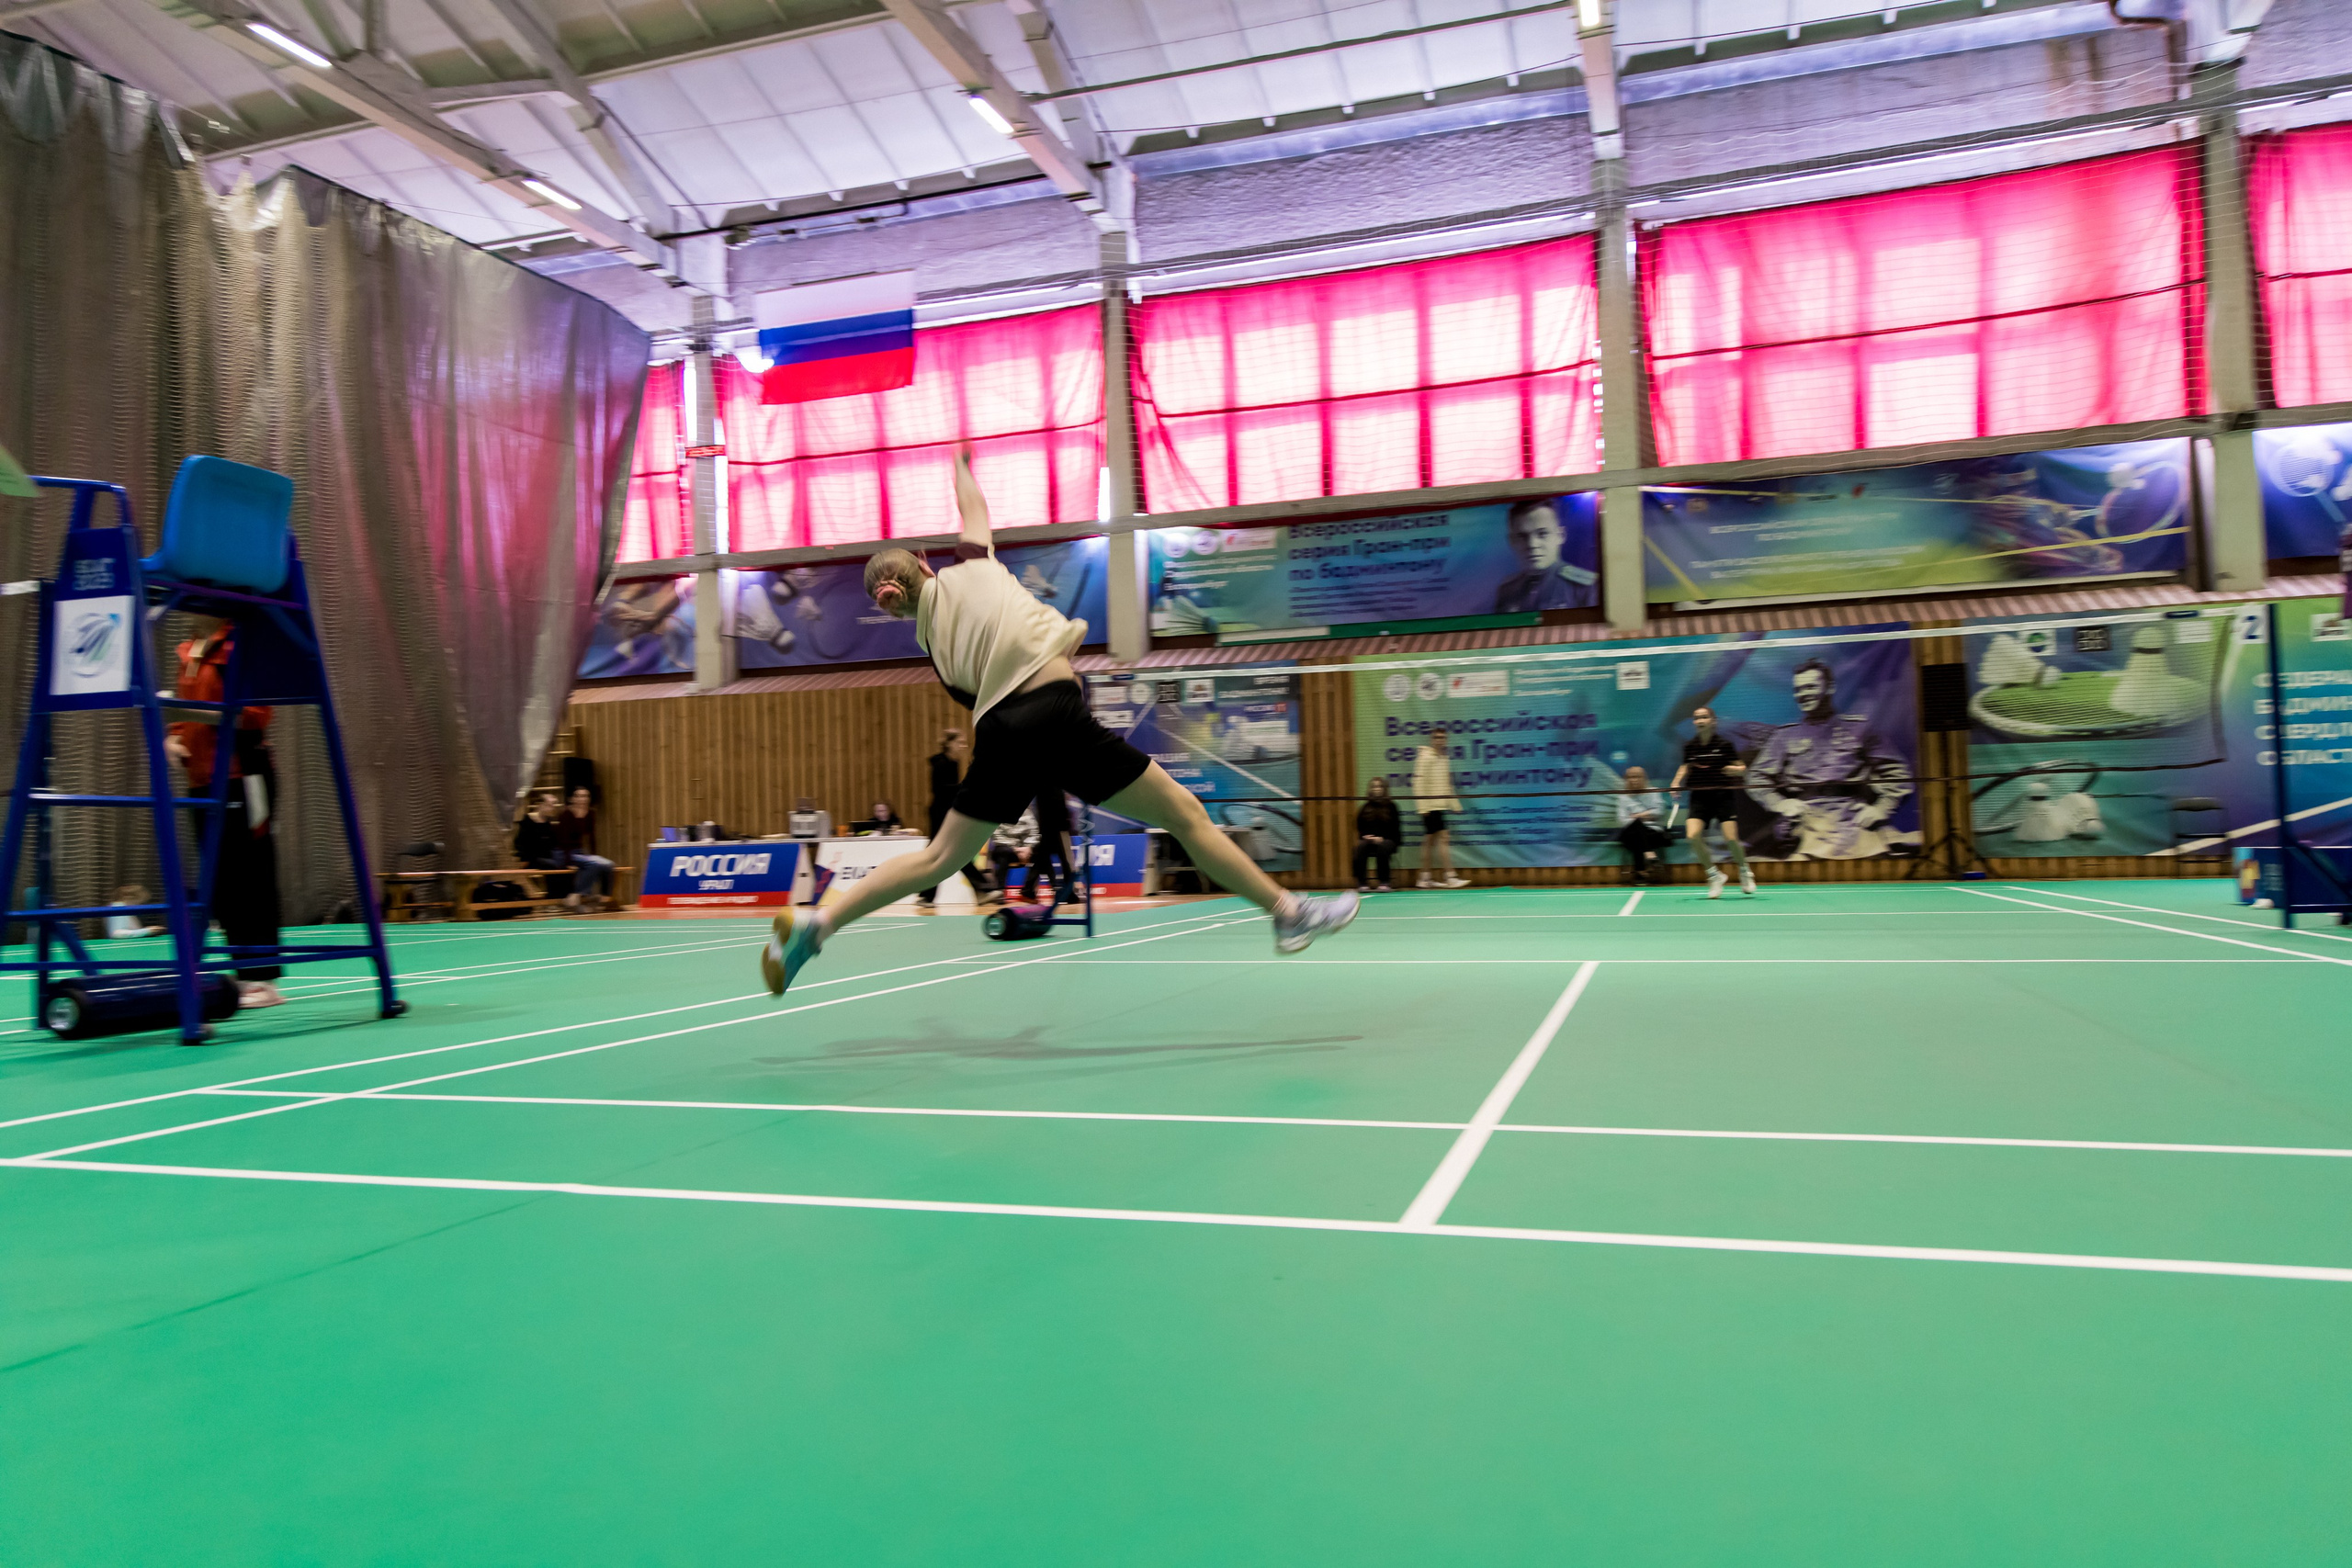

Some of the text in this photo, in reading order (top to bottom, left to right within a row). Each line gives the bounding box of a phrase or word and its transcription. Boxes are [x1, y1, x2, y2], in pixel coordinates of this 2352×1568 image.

[1288, 545, 1351, 562] серия
[1352, 536, 1451, 559] Гран-при
[1288, 569, 1315, 581] по
[1317, 558, 1447, 580] бадминтону
[2243, 615, 2258, 640] 2
[1385, 710, 1597, 736] Всероссийская
[1385, 739, 1598, 764] сея Гран-при
[670, 853, 772, 877] РОССИЯ
